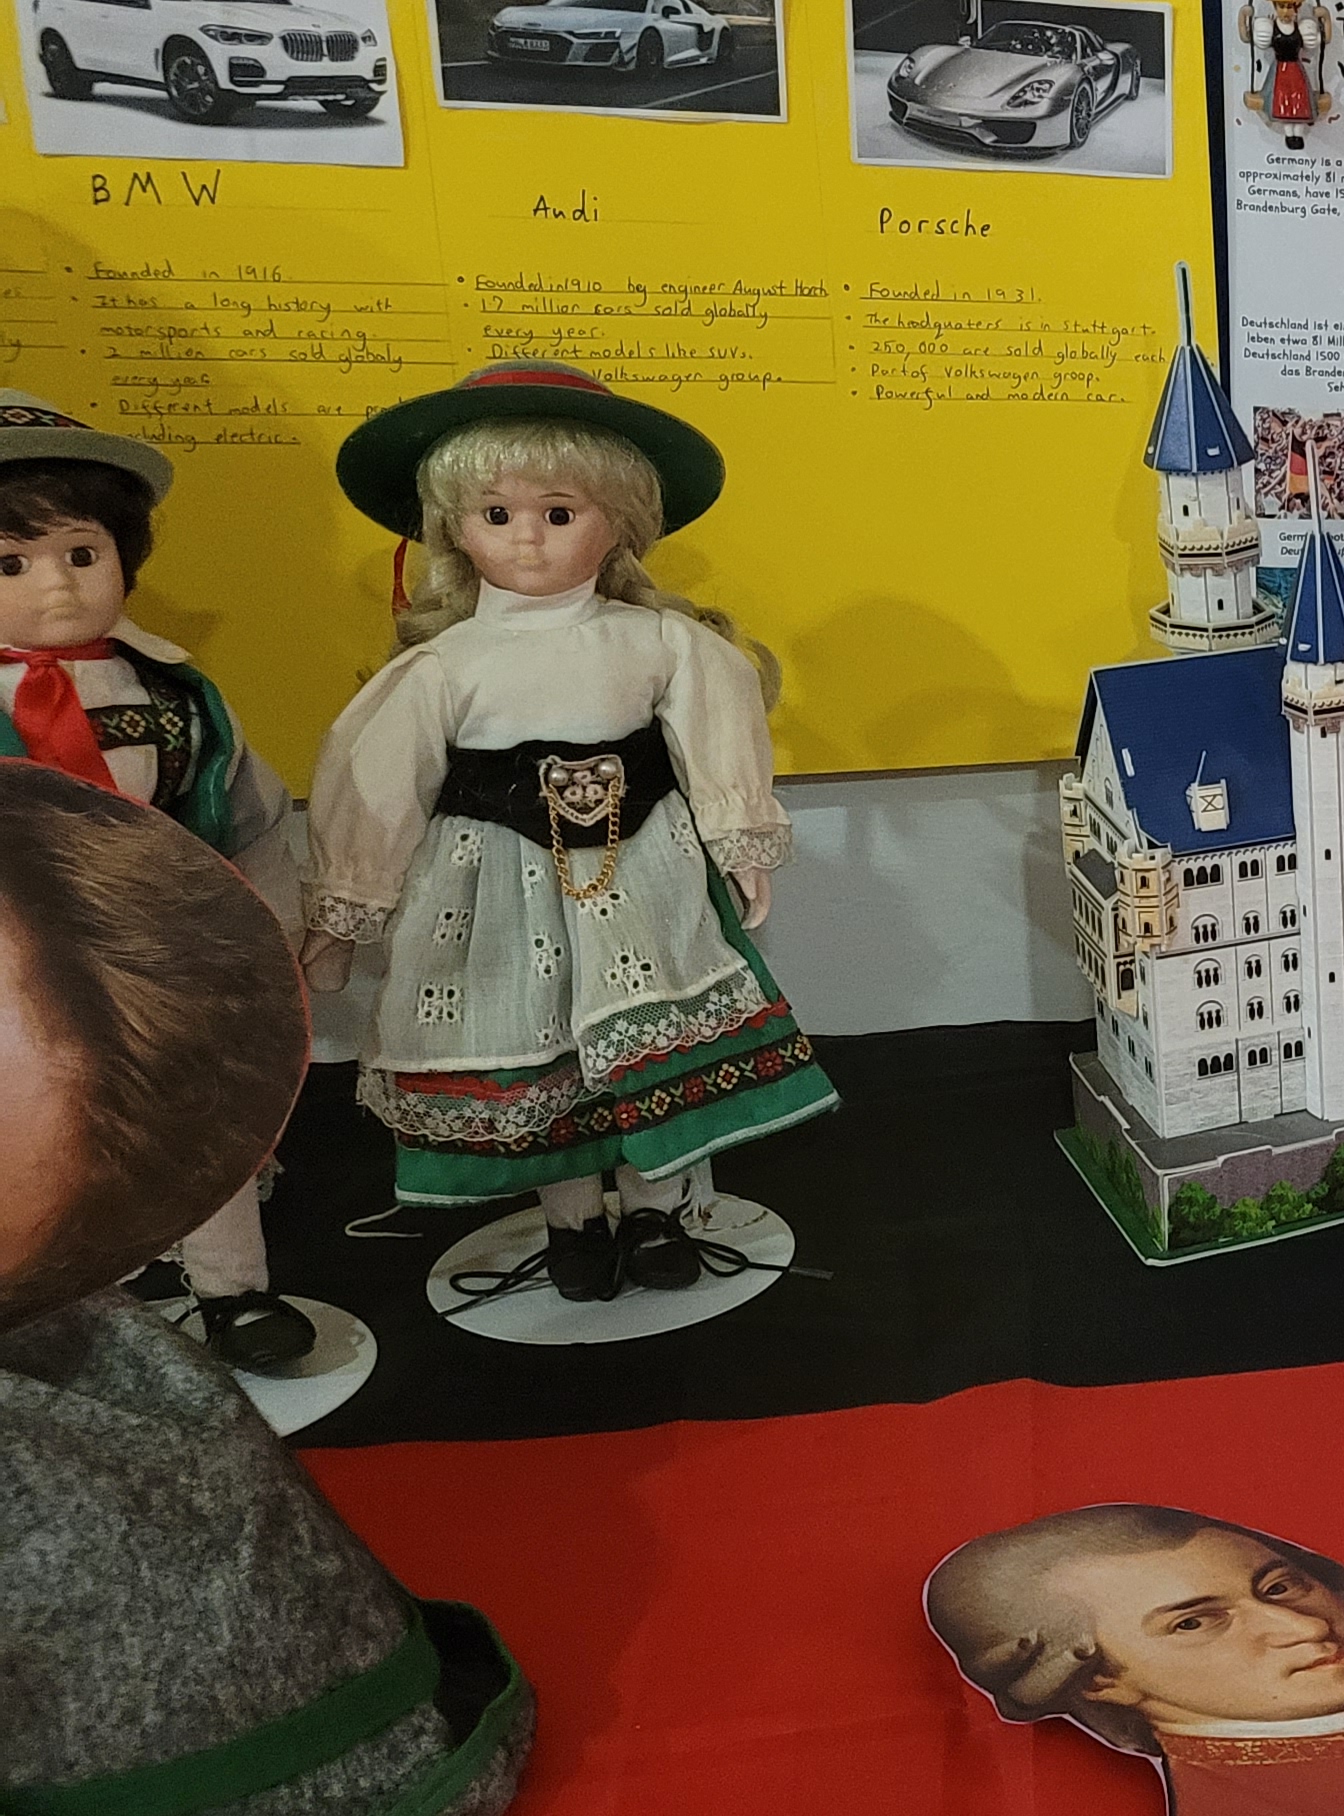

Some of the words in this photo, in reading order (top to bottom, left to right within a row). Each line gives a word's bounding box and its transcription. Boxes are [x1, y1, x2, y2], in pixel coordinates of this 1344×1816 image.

[533, 190, 599, 223] Audi
[878, 208, 992, 239] Porsche
[93, 260, 174, 279] Founded
[202, 268, 221, 279] in
[661, 282, 725, 303] engineer
[732, 279, 786, 301] August
[868, 280, 940, 301] Founded
[952, 285, 973, 302] in
[213, 292, 251, 318] long
[267, 295, 332, 322] history
[354, 296, 392, 312] with
[867, 313, 890, 327] The
[1019, 317, 1031, 332] is
[1040, 318, 1051, 332] in
[871, 340, 949, 363] 250,000
[962, 345, 991, 357] are
[1006, 343, 1044, 358] sold
[1056, 343, 1118, 369] globally
[1133, 347, 1167, 364] each
[909, 364, 930, 384] of
[875, 384, 952, 411] Powerful
[965, 388, 991, 402] and
[1007, 383, 1069, 402] modern
